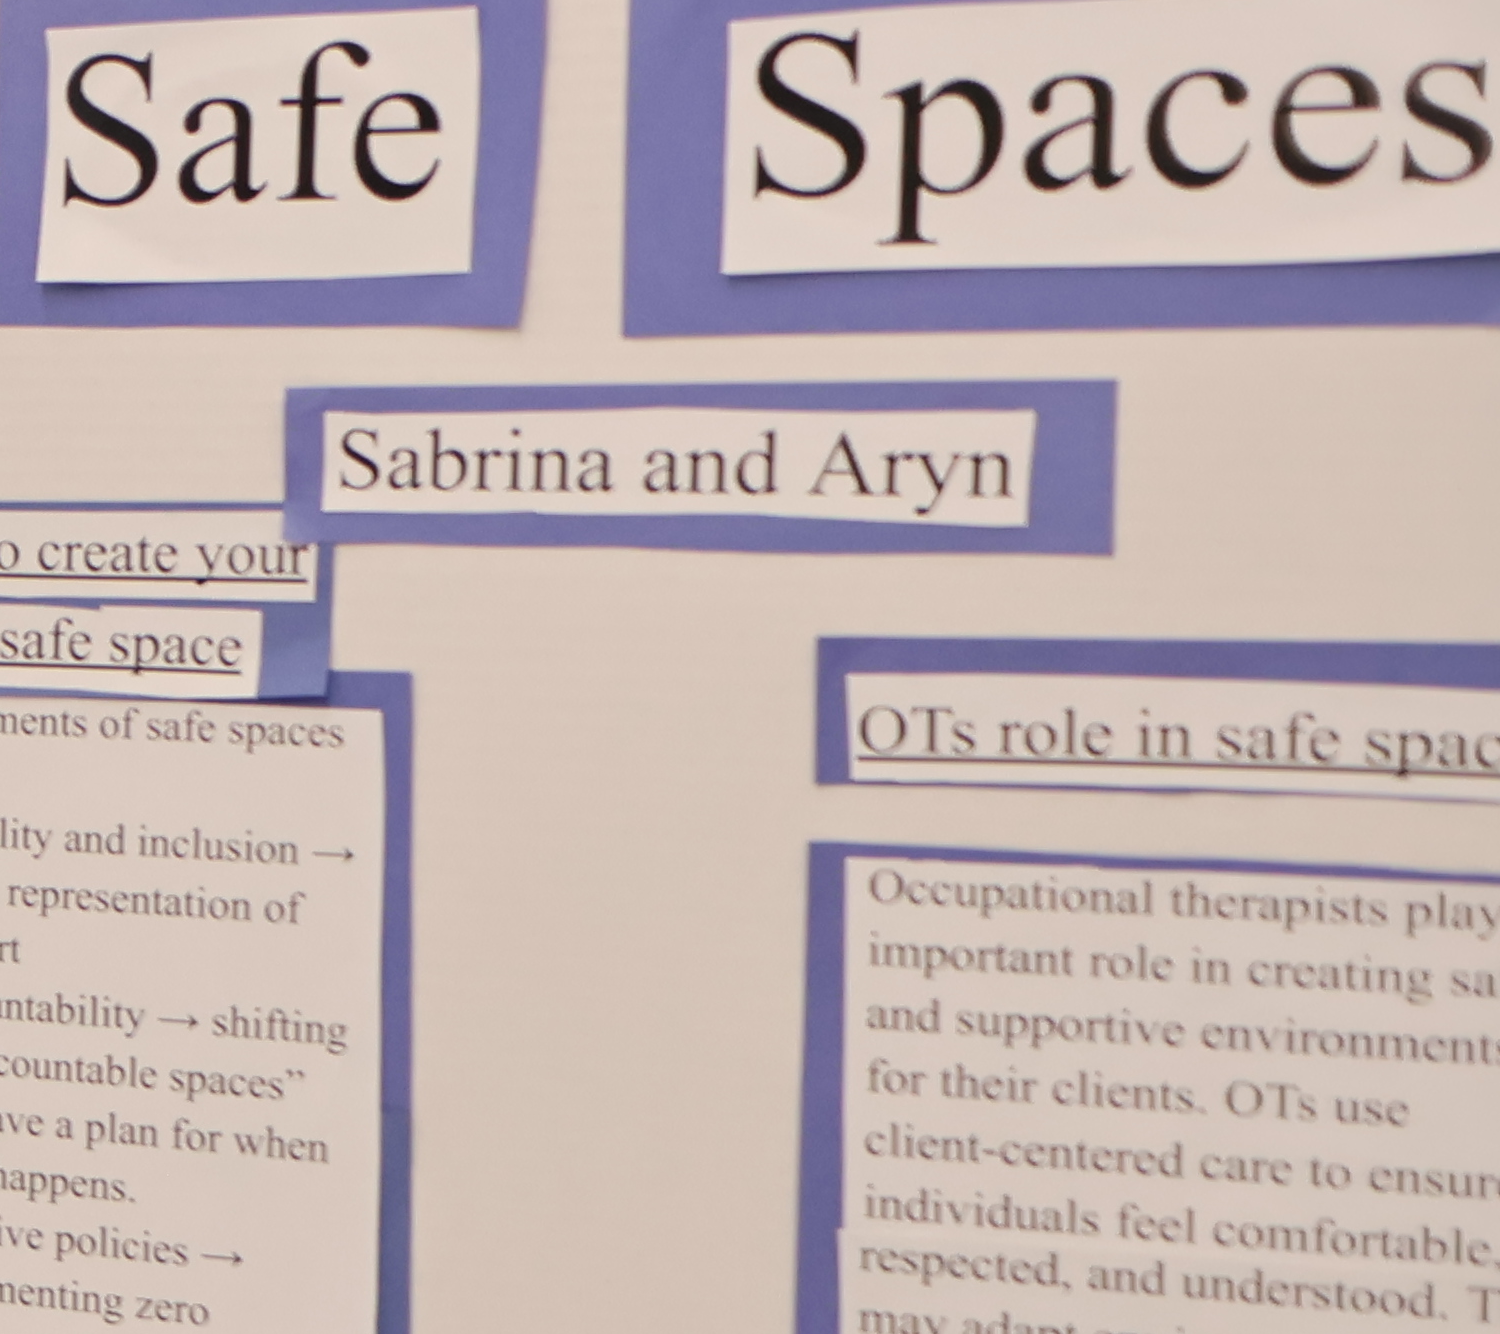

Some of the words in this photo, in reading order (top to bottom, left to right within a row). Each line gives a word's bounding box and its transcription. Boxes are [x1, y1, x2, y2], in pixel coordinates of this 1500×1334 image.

[62, 40, 441, 207] Safe
[753, 31, 1493, 244] Spaces
[339, 427, 613, 492] Sabrina
[642, 429, 777, 495] and
[809, 432, 1010, 516] Aryn
[36, 538, 178, 574] create
[196, 542, 310, 586] your
[0, 616, 93, 664] safe
[108, 631, 243, 676] space
[858, 704, 978, 757] OTs
[999, 707, 1114, 759] role
[1137, 708, 1192, 762] in
[1216, 711, 1341, 765] safe
[7, 883, 251, 921] representation
[262, 890, 306, 925] of
[867, 869, 1153, 920] Occupational
[1168, 879, 1388, 932] therapists
